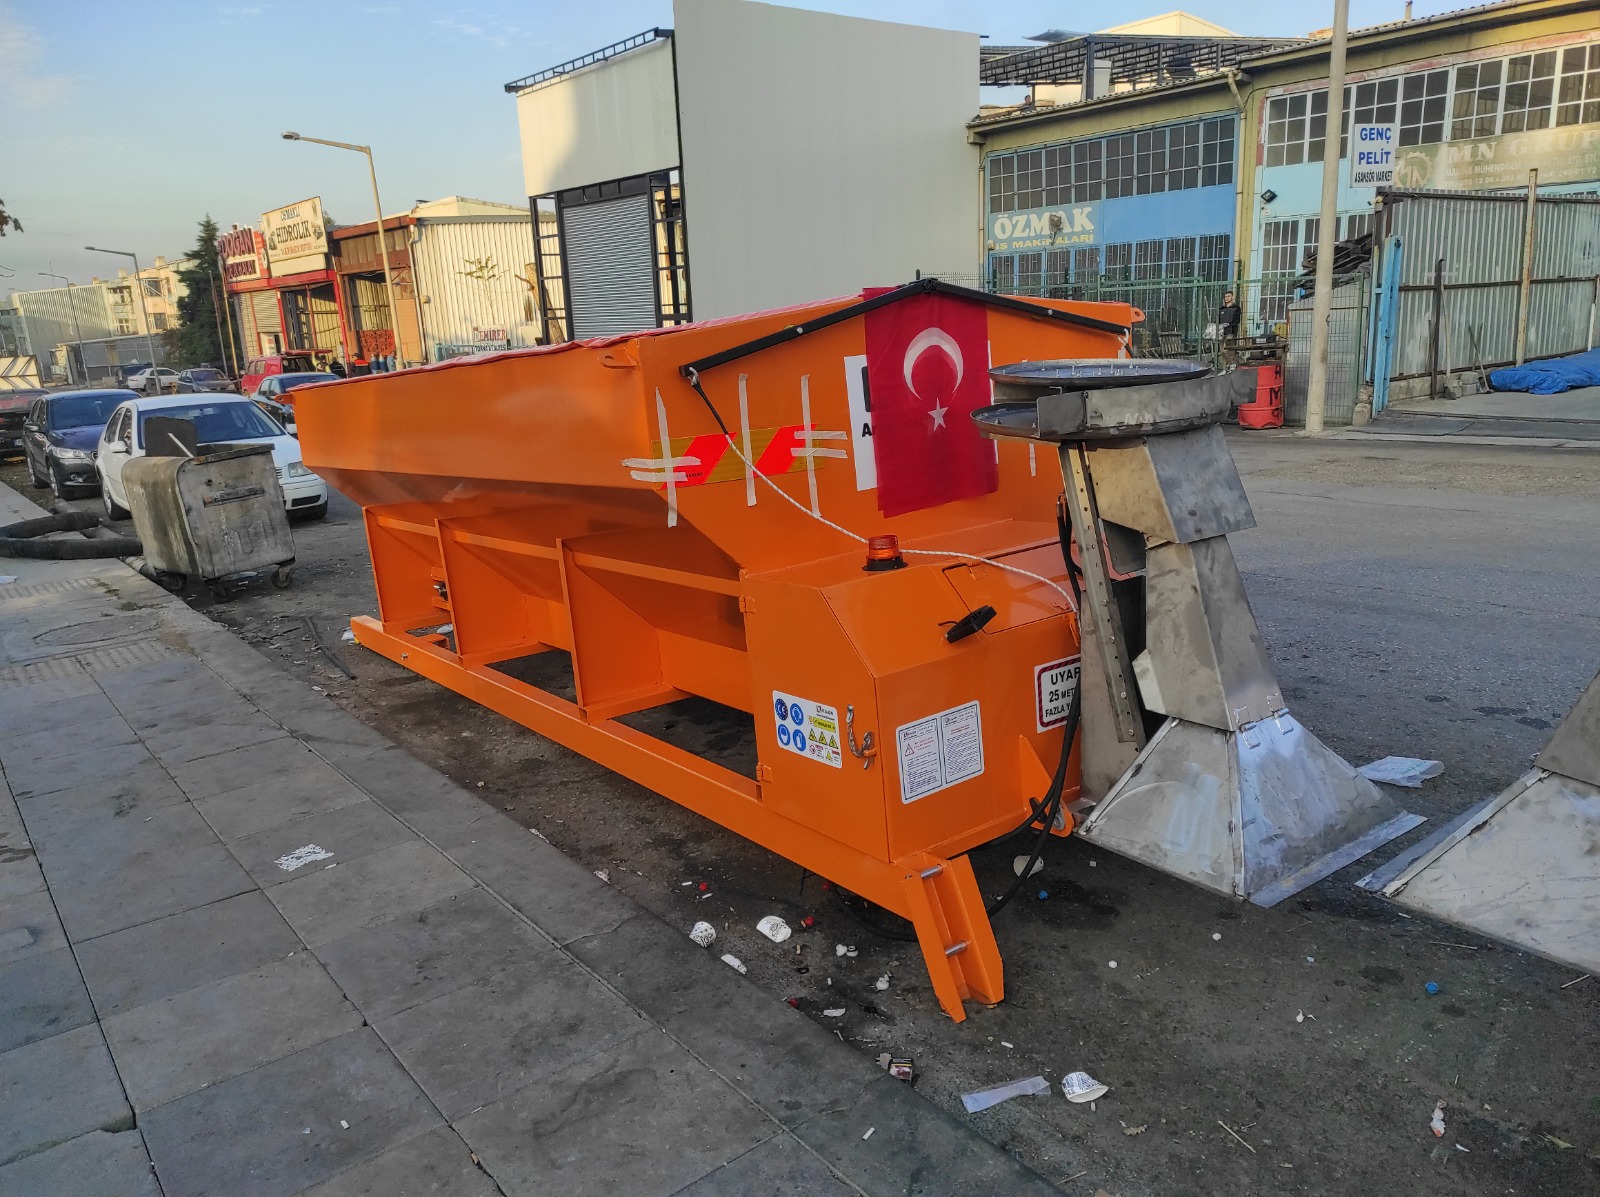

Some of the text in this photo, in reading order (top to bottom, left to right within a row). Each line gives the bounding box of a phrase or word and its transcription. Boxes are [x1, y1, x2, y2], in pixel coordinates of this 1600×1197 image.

[1360, 127, 1392, 144] GENÇ
[1358, 147, 1391, 165] PELİT
[1447, 141, 1499, 164] MN
[1376, 170, 1392, 182] MARKET
[1048, 689, 1060, 703] 25
[1045, 704, 1065, 718] FAZLA
